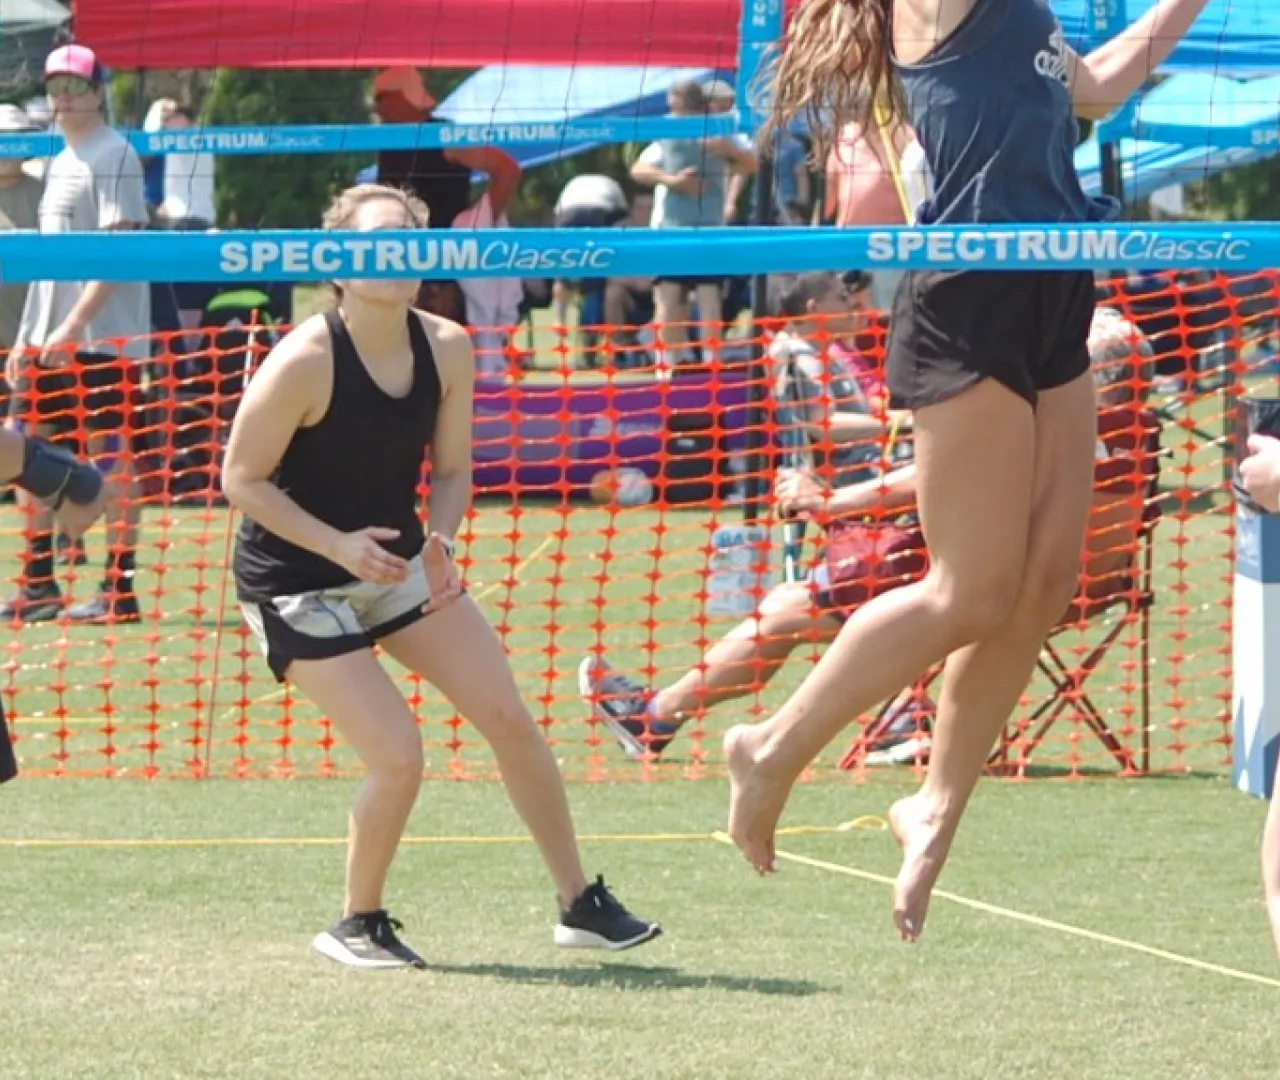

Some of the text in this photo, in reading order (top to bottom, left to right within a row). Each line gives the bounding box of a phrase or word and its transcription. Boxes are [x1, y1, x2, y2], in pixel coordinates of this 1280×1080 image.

[149, 133, 266, 150] SPECTRUM
[219, 239, 616, 274] SPECTRUM Classic
[866, 230, 1251, 261] SPECTRUM Classic
